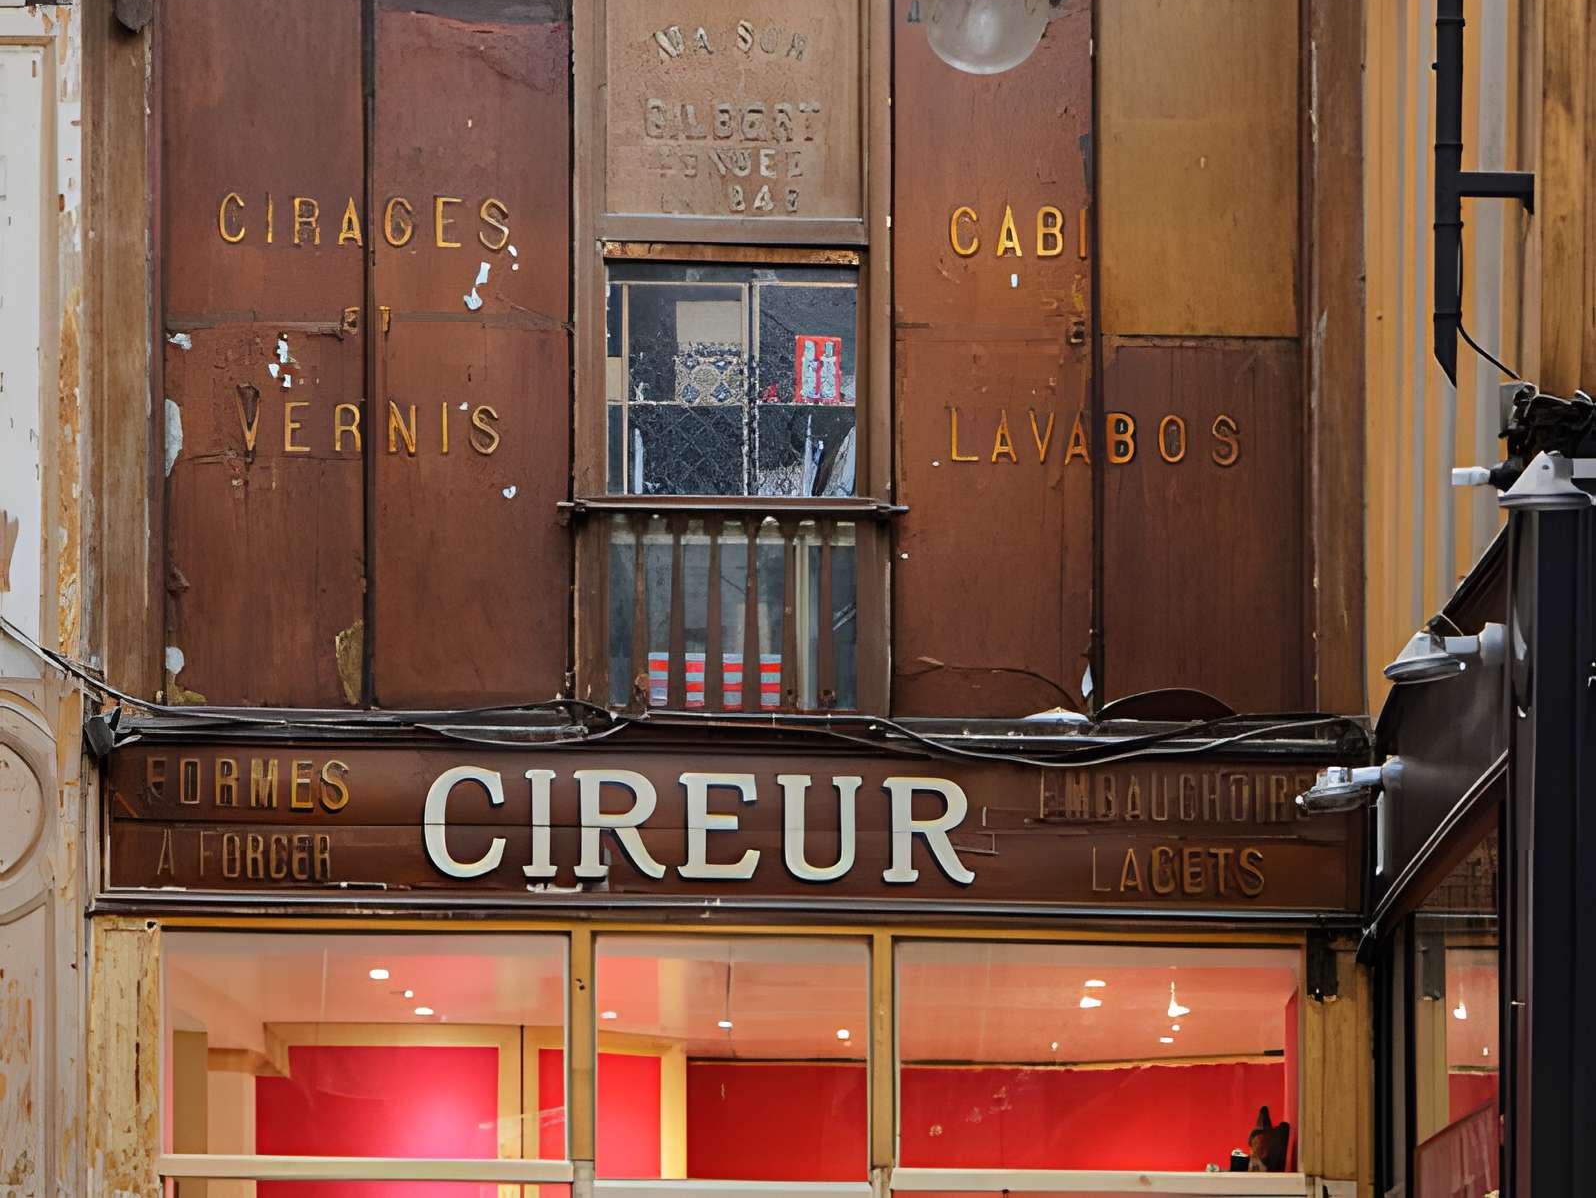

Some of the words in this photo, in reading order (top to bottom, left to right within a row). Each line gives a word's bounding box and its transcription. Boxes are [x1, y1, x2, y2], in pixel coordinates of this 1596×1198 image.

[218, 192, 510, 251] CIRAGES
[236, 385, 502, 456] VERNIS
[949, 408, 1242, 468] LAVABOS
[146, 757, 350, 812] FORMES
[422, 764, 977, 886] CIREUR
[1092, 845, 1265, 896] LACETS
